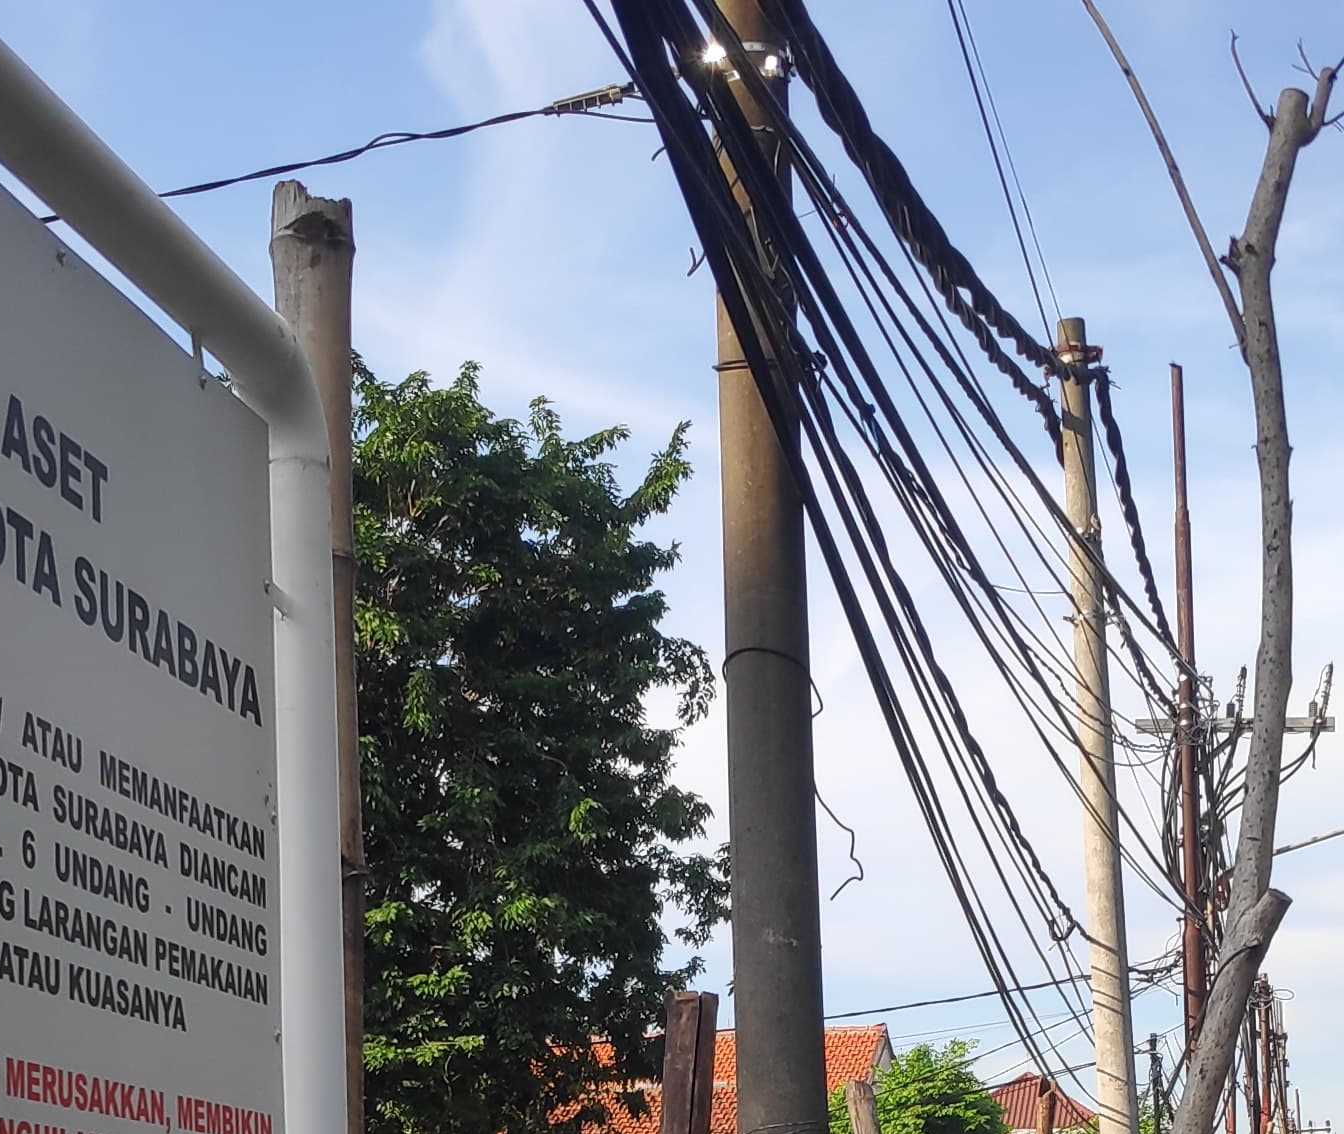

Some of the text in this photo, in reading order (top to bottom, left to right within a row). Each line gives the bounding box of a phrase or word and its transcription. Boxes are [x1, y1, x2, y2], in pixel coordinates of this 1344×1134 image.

[1, 393, 108, 524] ASET
[73, 556, 263, 728] SURABAYA
[21, 711, 82, 774] ATAU
[99, 750, 265, 861] MEMANFAATKAN
[52, 784, 169, 869] SURABAYA
[179, 841, 267, 910] DIANCAM
[22, 829, 36, 870] 6
[54, 842, 150, 914] UNDANG
[186, 896, 268, 957] UNDANG
[23, 888, 148, 968] LARANGAN
[154, 936, 268, 1006] PEMAKAIAN
[68, 963, 187, 1033] KUASANYA
[5, 1056, 171, 1134] MERUSAKKAN,
